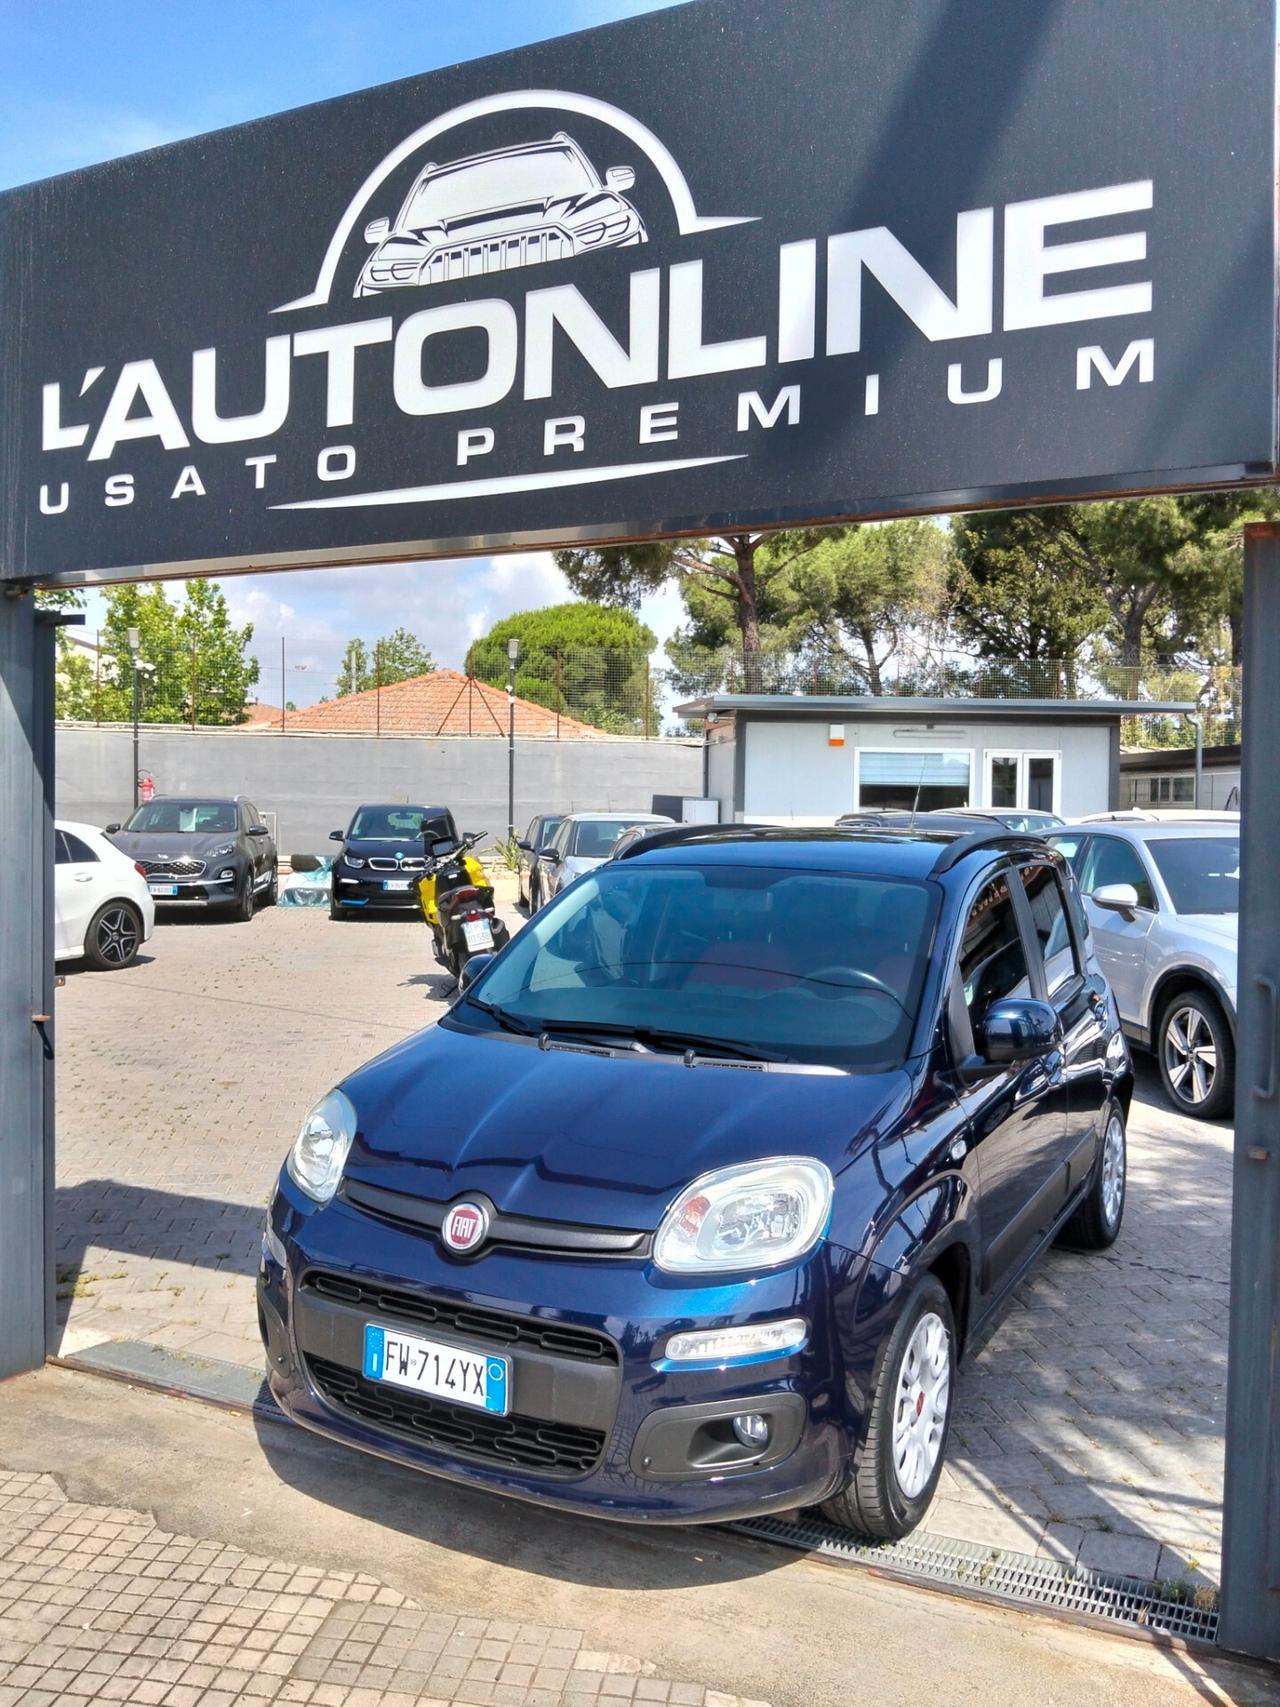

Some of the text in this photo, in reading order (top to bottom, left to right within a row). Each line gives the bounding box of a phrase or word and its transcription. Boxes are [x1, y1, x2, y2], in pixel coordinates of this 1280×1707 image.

[39, 338, 1155, 515] USATO PREMIUM
[451, 1215, 477, 1240] FIAT
